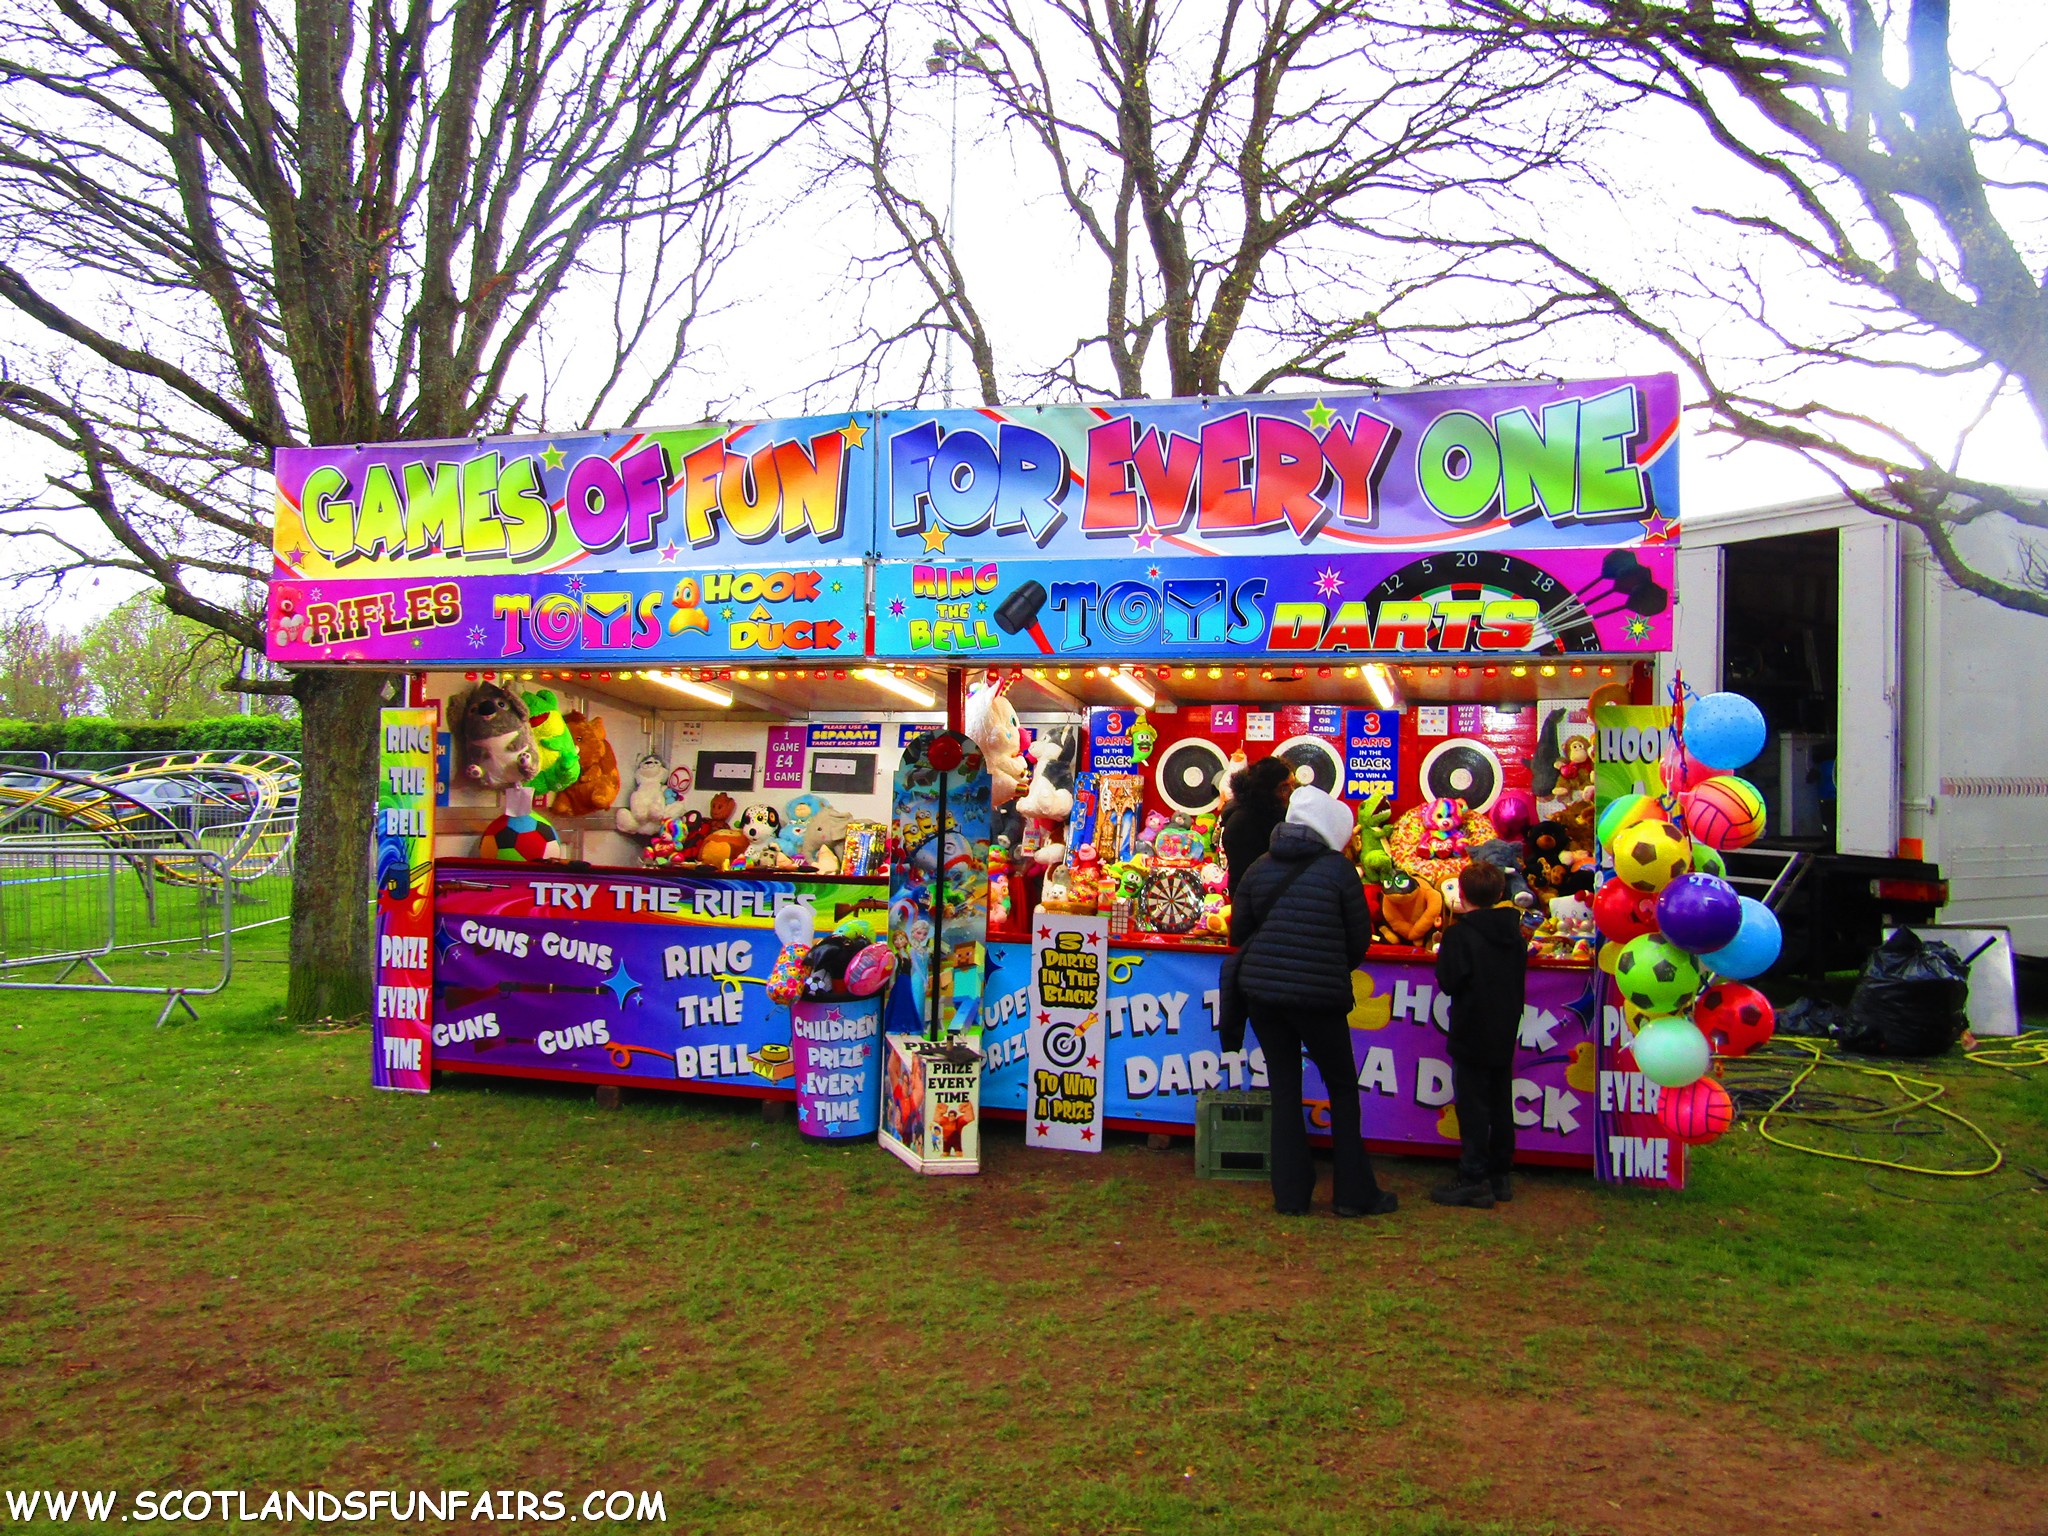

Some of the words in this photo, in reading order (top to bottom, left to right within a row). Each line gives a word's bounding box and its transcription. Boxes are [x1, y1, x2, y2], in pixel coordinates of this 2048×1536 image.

[301, 451, 555, 566] GAMES
[566, 443, 672, 554] OF
[682, 428, 851, 549] FUN
[888, 417, 1070, 547] FOR
[1078, 408, 1403, 544] EVERY
[1416, 384, 1657, 529] ONE
[703, 570, 823, 603] HOOK
[912, 563, 998, 601] RING
[1381, 574, 1404, 595] 12
[1421, 559, 1434, 574] 5
[1456, 553, 1478, 567] 20
[1500, 557, 1511, 572] 1
[1531, 571, 1555, 593] 18
[307, 582, 461, 649] RIFLES
[493, 590, 663, 657] TOYS
[749, 603, 772, 621] A
[936, 603, 971, 620] THE
[1049, 578, 1269, 651] TOYS
[1265, 599, 1541, 652] DARTS
[729, 619, 844, 650] DUCK
[909, 619, 1000, 652] BELL
[1107, 712, 1122, 734] 3
[1214, 711, 1233, 726] £4
[1312, 725, 1336, 733] CARD
[1364, 712, 1380, 735] 3
[386, 724, 431, 753] RING
[772, 742, 799, 753] GAME
[783, 731, 789, 740] 1
[811, 731, 877, 741] SEPARATE
[1095, 736, 1132, 746] DARTS
[1351, 737, 1391, 748] DARTS
[775, 754, 793, 768] £4
[1094, 755, 1132, 768] BLACK
[1350, 757, 1391, 771] BLACK
[389, 767, 426, 796] THE
[765, 772, 771, 781] 1
[774, 772, 801, 781] GAME
[1348, 780, 1394, 795] PRIZE
[386, 808, 428, 837] BELL
[529, 881, 599, 910] TRY
[609, 885, 681, 913] THE
[381, 935, 428, 970] PRIZE
[460, 920, 529, 958] GUNS
[541, 932, 613, 971] GUNS
[1058, 932, 1083, 950] 3
[662, 940, 753, 980] RING
[1044, 950, 1097, 970] DARTS
[1042, 968, 1059, 985] IN
[1066, 970, 1098, 987] THE
[378, 986, 429, 1020] EVERY
[678, 990, 744, 1028] THE
[1043, 985, 1096, 1005] BLACK
[795, 1013, 878, 1042] CHILDREN
[1106, 991, 1190, 1038] TRY
[1392, 980, 1559, 1052] HK
[431, 1012, 500, 1047] GUNS
[538, 1019, 610, 1056] GUNS
[383, 1037, 421, 1072] TIME
[675, 1043, 754, 1080] BELL
[808, 1044, 863, 1070] PRIZE
[933, 1063, 973, 1074] PRIZE
[807, 1072, 865, 1097] EVERY
[928, 1077, 977, 1088] EVERY
[1037, 1070, 1058, 1094] TO
[1063, 1073, 1095, 1097] WIN
[1125, 1048, 1269, 1099] DARTS
[935, 1092, 969, 1103] TIME
[1358, 1046, 1398, 1097] A
[1415, 1057, 1581, 1134] DCK
[1600, 1070, 1662, 1115] EVER
[814, 1098, 860, 1123] TIME
[1037, 1098, 1048, 1116] A
[1052, 1100, 1094, 1120] PRIZE
[1609, 1136, 1668, 1179] TIME
